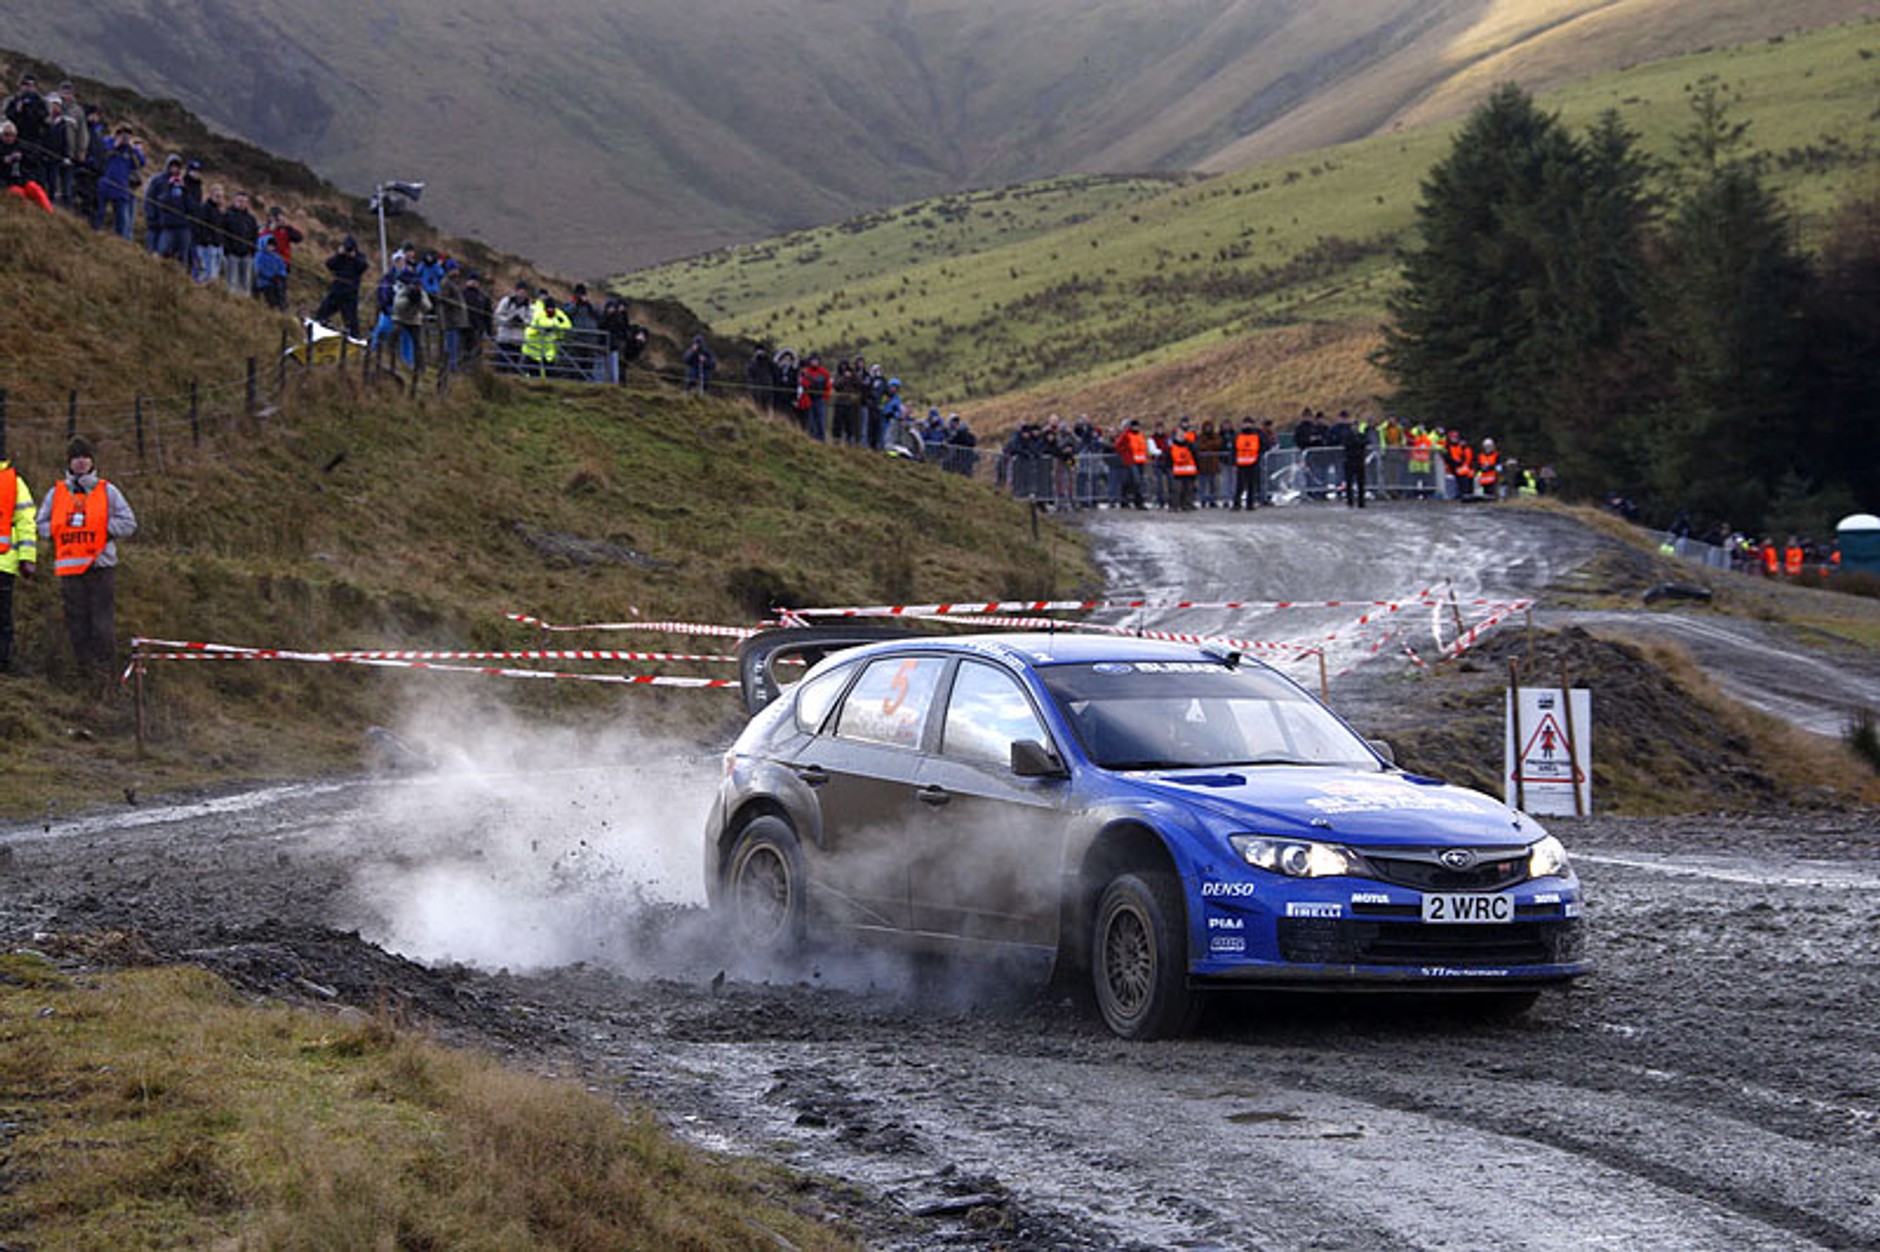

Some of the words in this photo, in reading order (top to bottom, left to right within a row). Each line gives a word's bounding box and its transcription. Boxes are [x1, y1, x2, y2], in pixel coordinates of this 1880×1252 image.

[882, 658, 918, 715] 5
[1201, 886, 1254, 896] DENSO
[1286, 902, 1342, 917] PIRELLI
[1430, 896, 1445, 919] 2
[1451, 896, 1508, 920] WRC
[1208, 918, 1244, 929] PIAA
